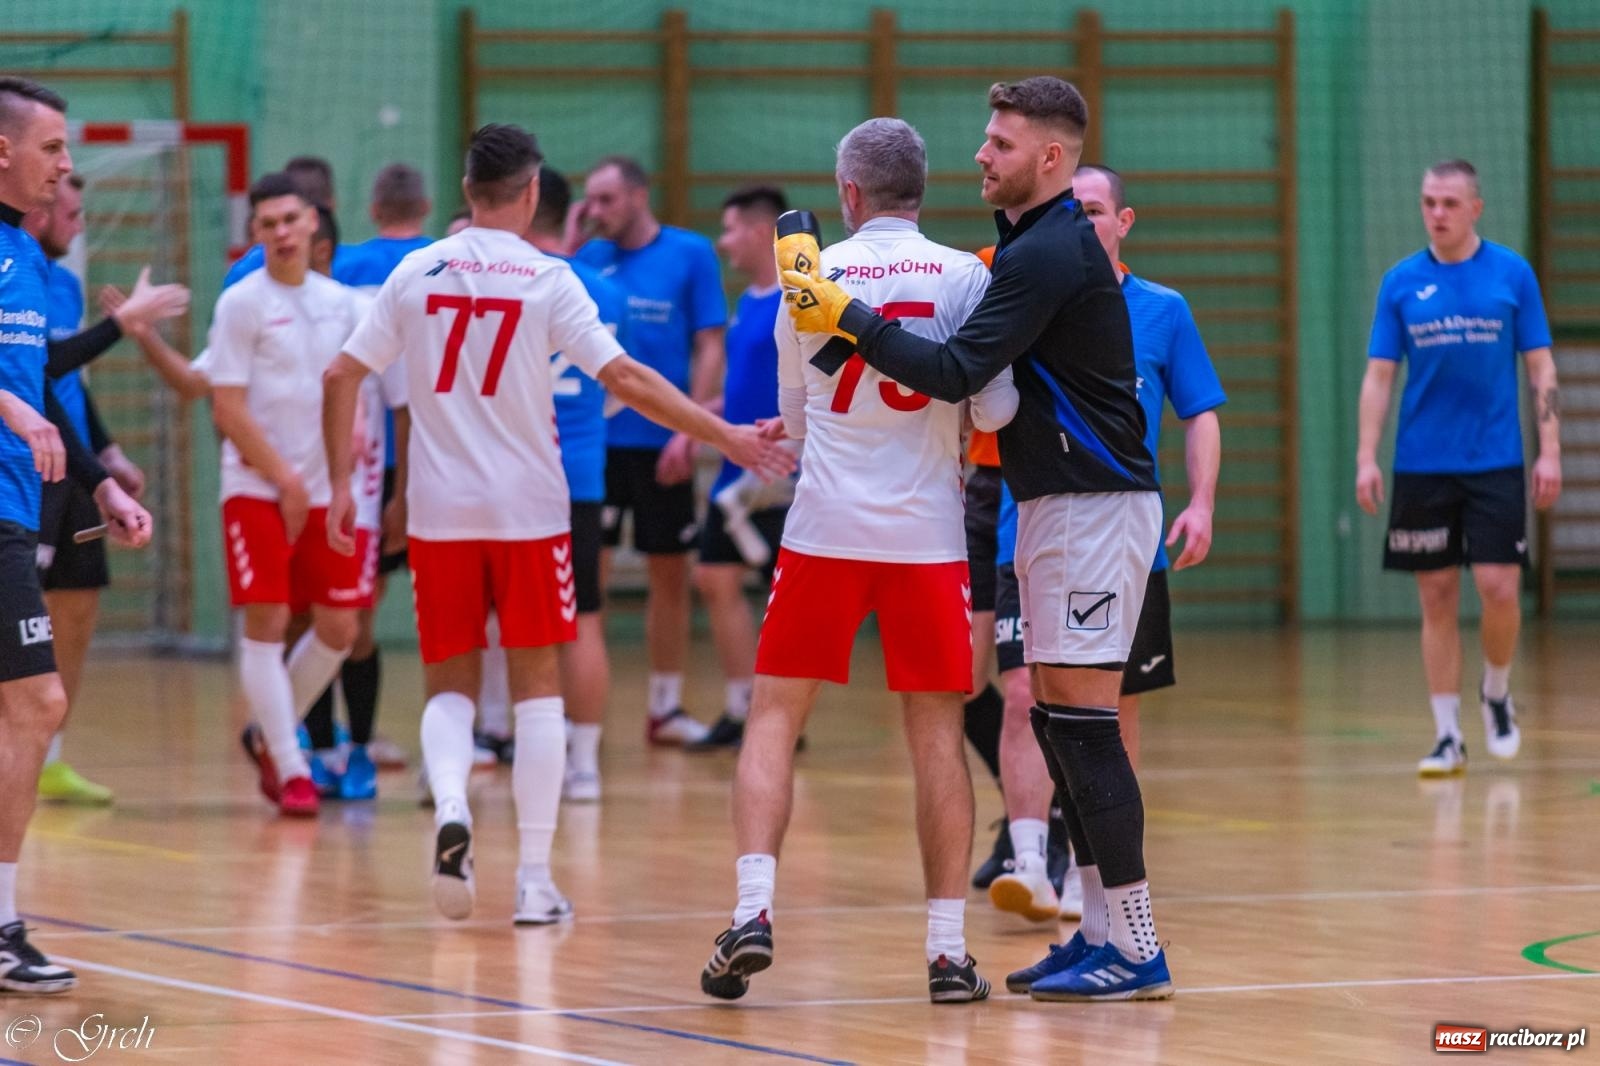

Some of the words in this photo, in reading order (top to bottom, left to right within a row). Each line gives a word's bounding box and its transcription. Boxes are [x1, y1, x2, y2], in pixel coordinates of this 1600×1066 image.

[845, 265, 885, 279] PRD
[888, 259, 943, 276] KÜHN
[426, 294, 523, 397] 77
